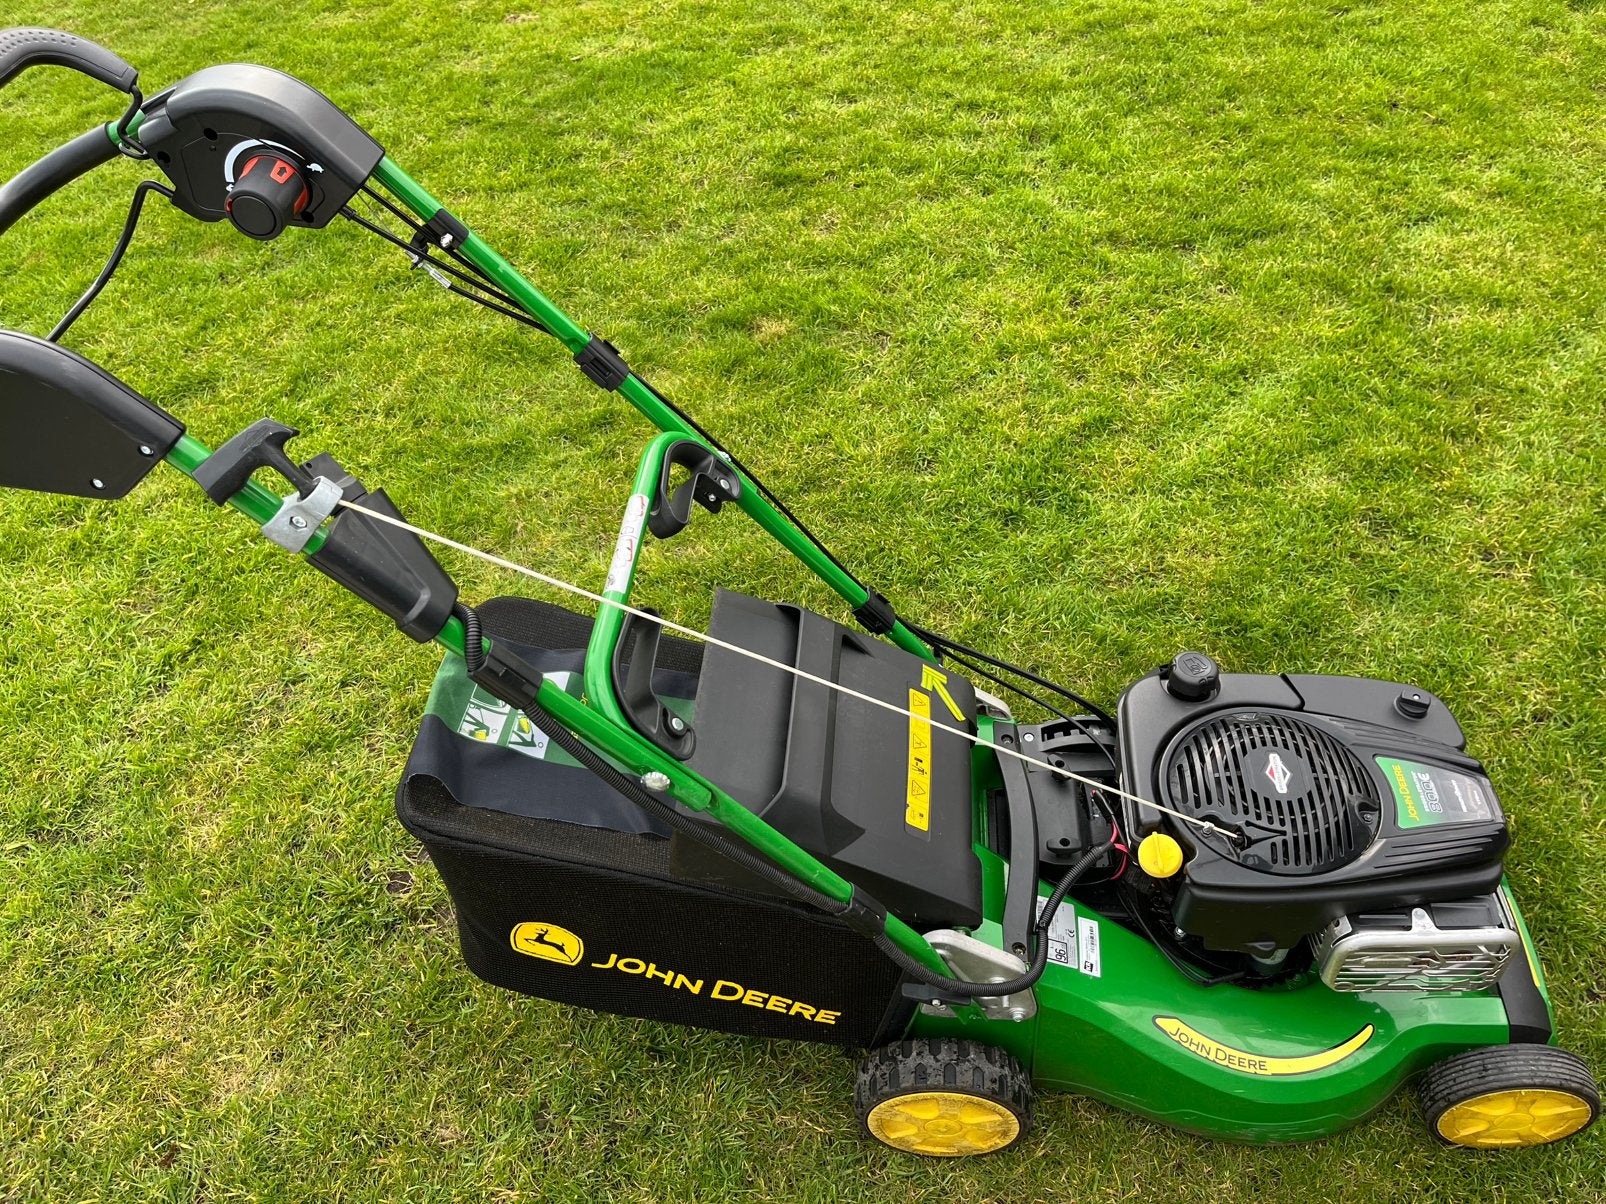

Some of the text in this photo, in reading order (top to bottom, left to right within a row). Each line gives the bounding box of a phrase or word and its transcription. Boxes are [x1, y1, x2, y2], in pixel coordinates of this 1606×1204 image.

[1392, 765, 1420, 821] JOHN DEERE
[1055, 948, 1067, 961] 96
[591, 954, 842, 1024] JOHN DEERE
[1169, 1027, 1268, 1071] JOHN DEERE
